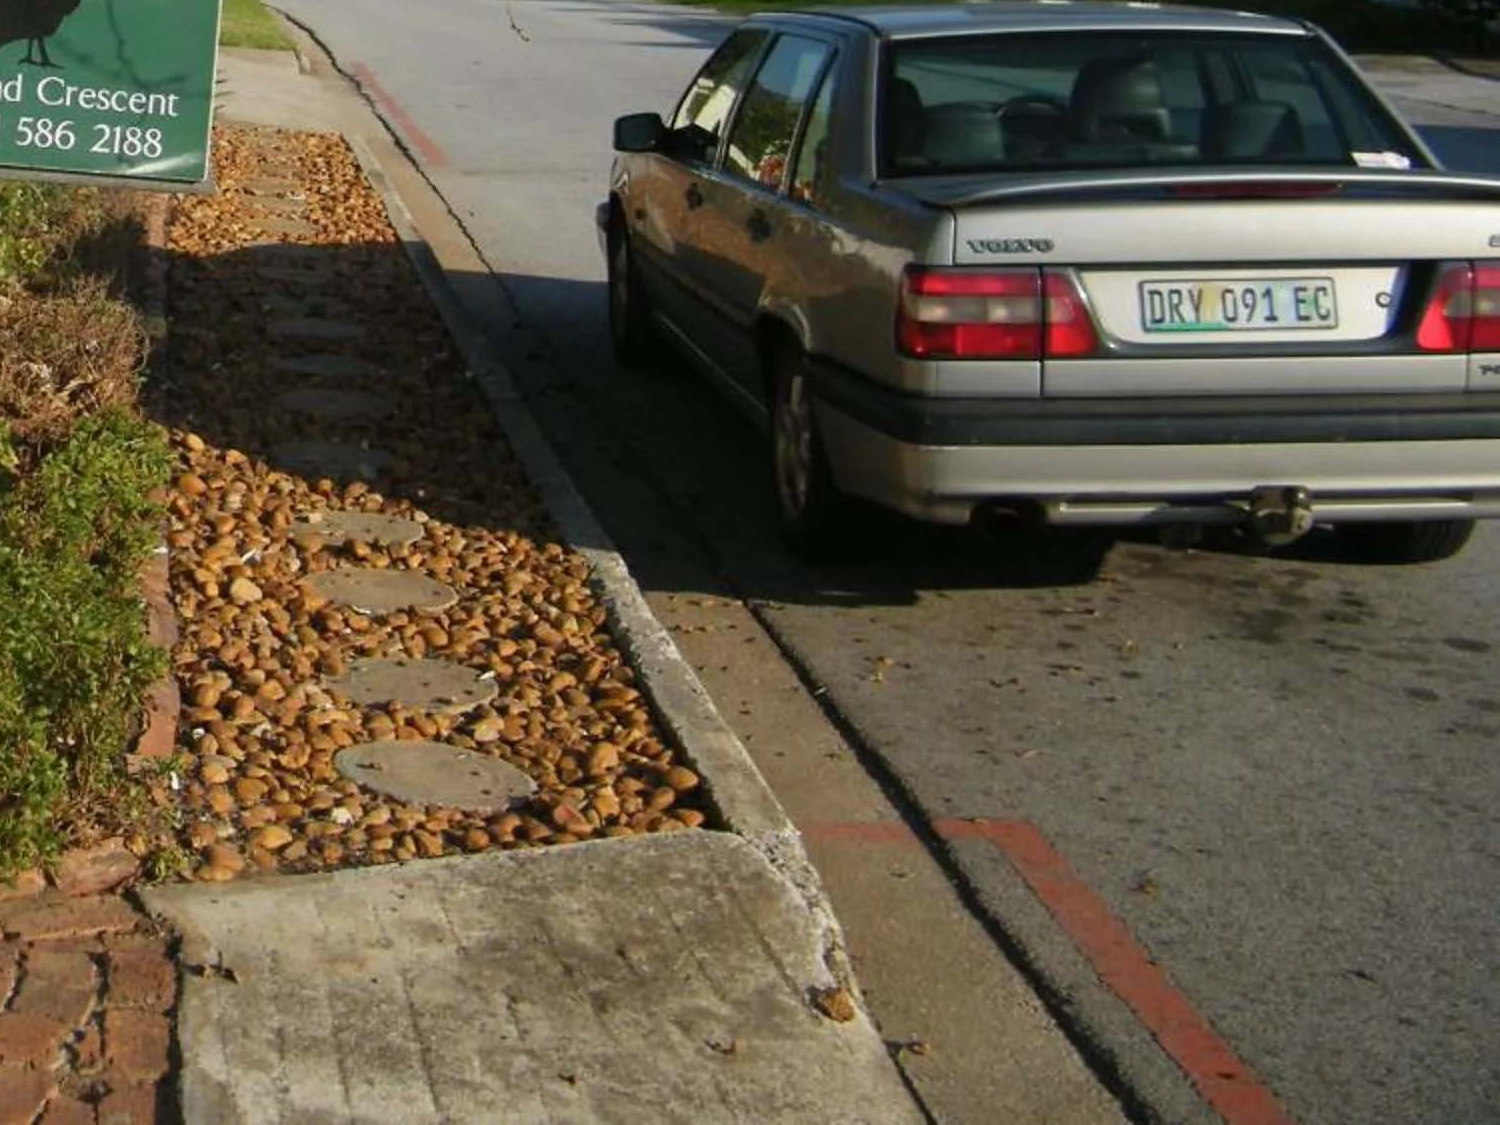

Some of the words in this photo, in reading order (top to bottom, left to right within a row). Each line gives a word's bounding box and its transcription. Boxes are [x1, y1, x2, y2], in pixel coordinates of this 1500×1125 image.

[36, 76, 180, 118] Crescent
[15, 116, 76, 150] 586
[90, 123, 164, 159] 2188
[966, 238, 1055, 254] VOLVO
[1147, 287, 1203, 324] DRY
[1221, 285, 1278, 323] 091
[1293, 285, 1332, 322] EC
